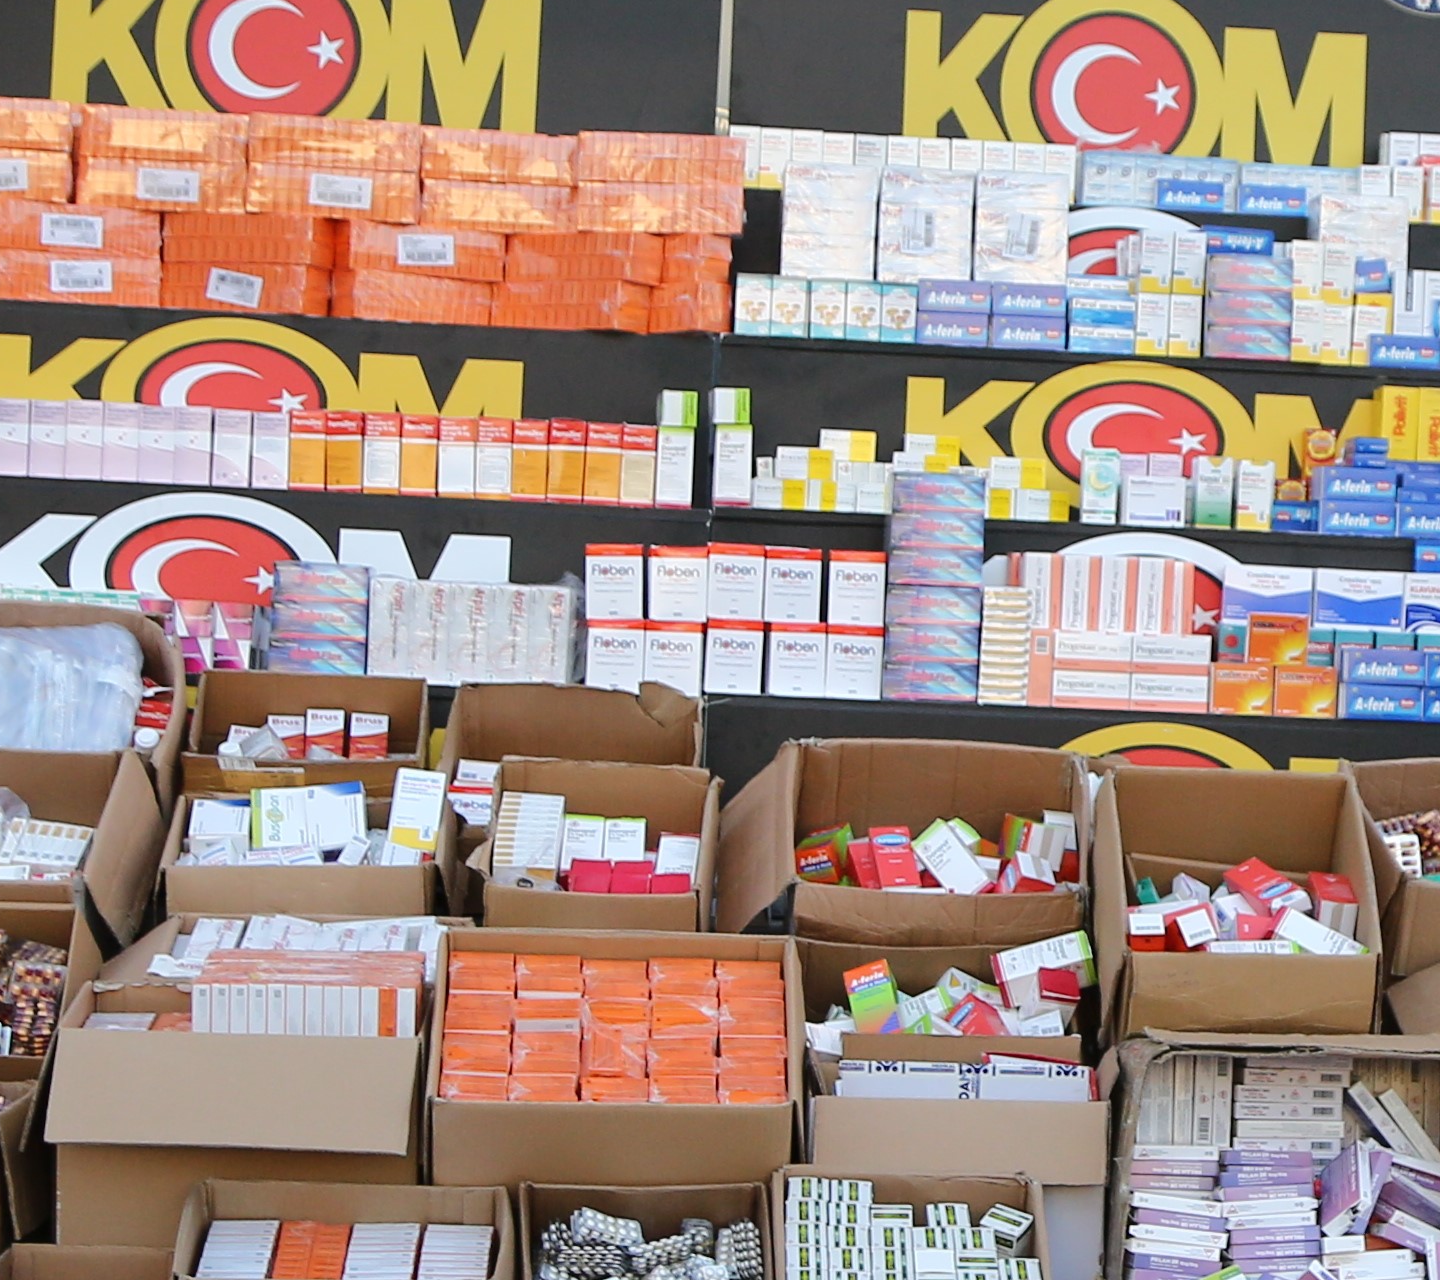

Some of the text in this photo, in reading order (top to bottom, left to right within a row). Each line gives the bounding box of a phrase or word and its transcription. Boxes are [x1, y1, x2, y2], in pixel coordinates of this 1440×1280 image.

[591, 564, 636, 577] Floben
[656, 565, 701, 580] Floben
[714, 562, 758, 577] Floben
[771, 566, 814, 581] Floben
[835, 569, 879, 583] Floben
[593, 636, 638, 651] Floben
[650, 638, 694, 654] Floben
[713, 637, 756, 652] Floben
[776, 640, 820, 655] Floben
[833, 642, 877, 657] Floben
[272, 717, 300, 726] Brus
[311, 712, 339, 722] Brus
[355, 716, 383, 725] Brus
